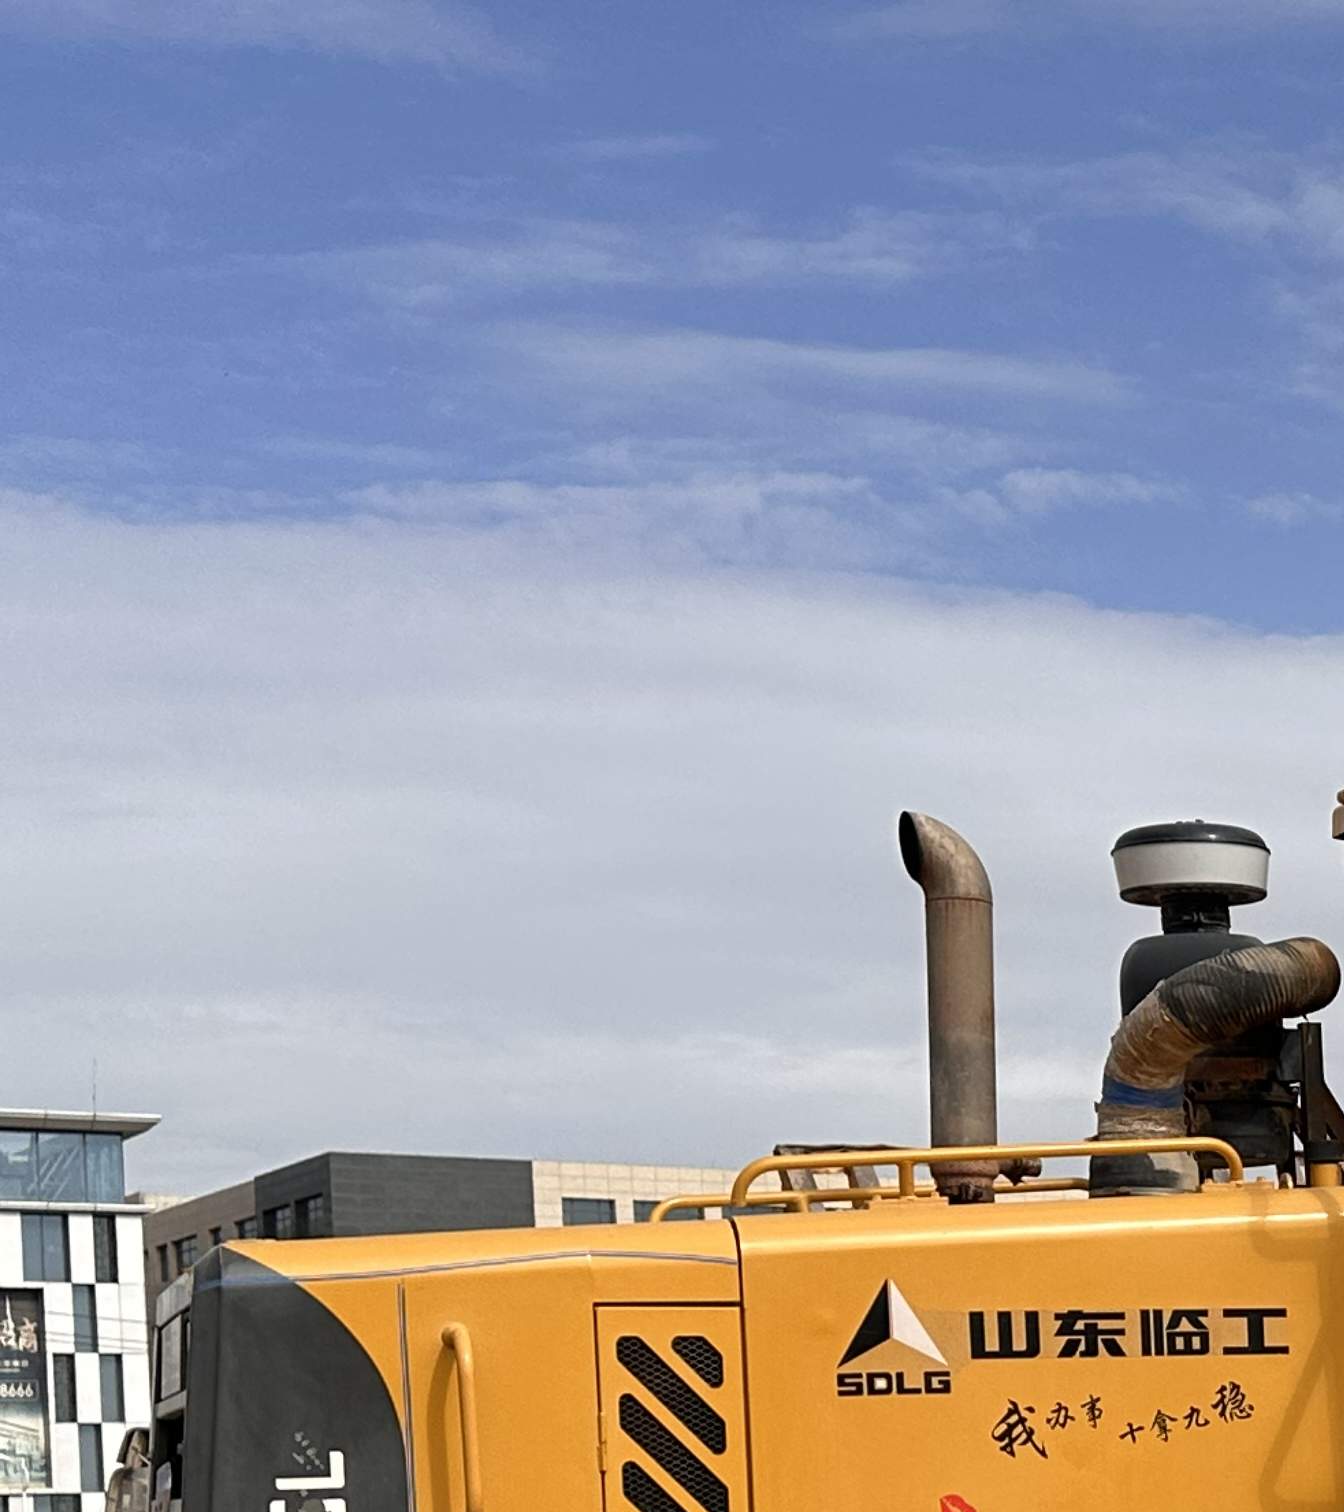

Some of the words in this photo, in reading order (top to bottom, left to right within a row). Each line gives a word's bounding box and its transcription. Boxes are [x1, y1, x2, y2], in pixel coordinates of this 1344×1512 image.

[968, 1307, 1290, 1360] 山东临工
[836, 1371, 952, 1397] SDLG
[991, 1393, 1103, 1459] 我办事
[1118, 1380, 1255, 1444] 十拿九稳
